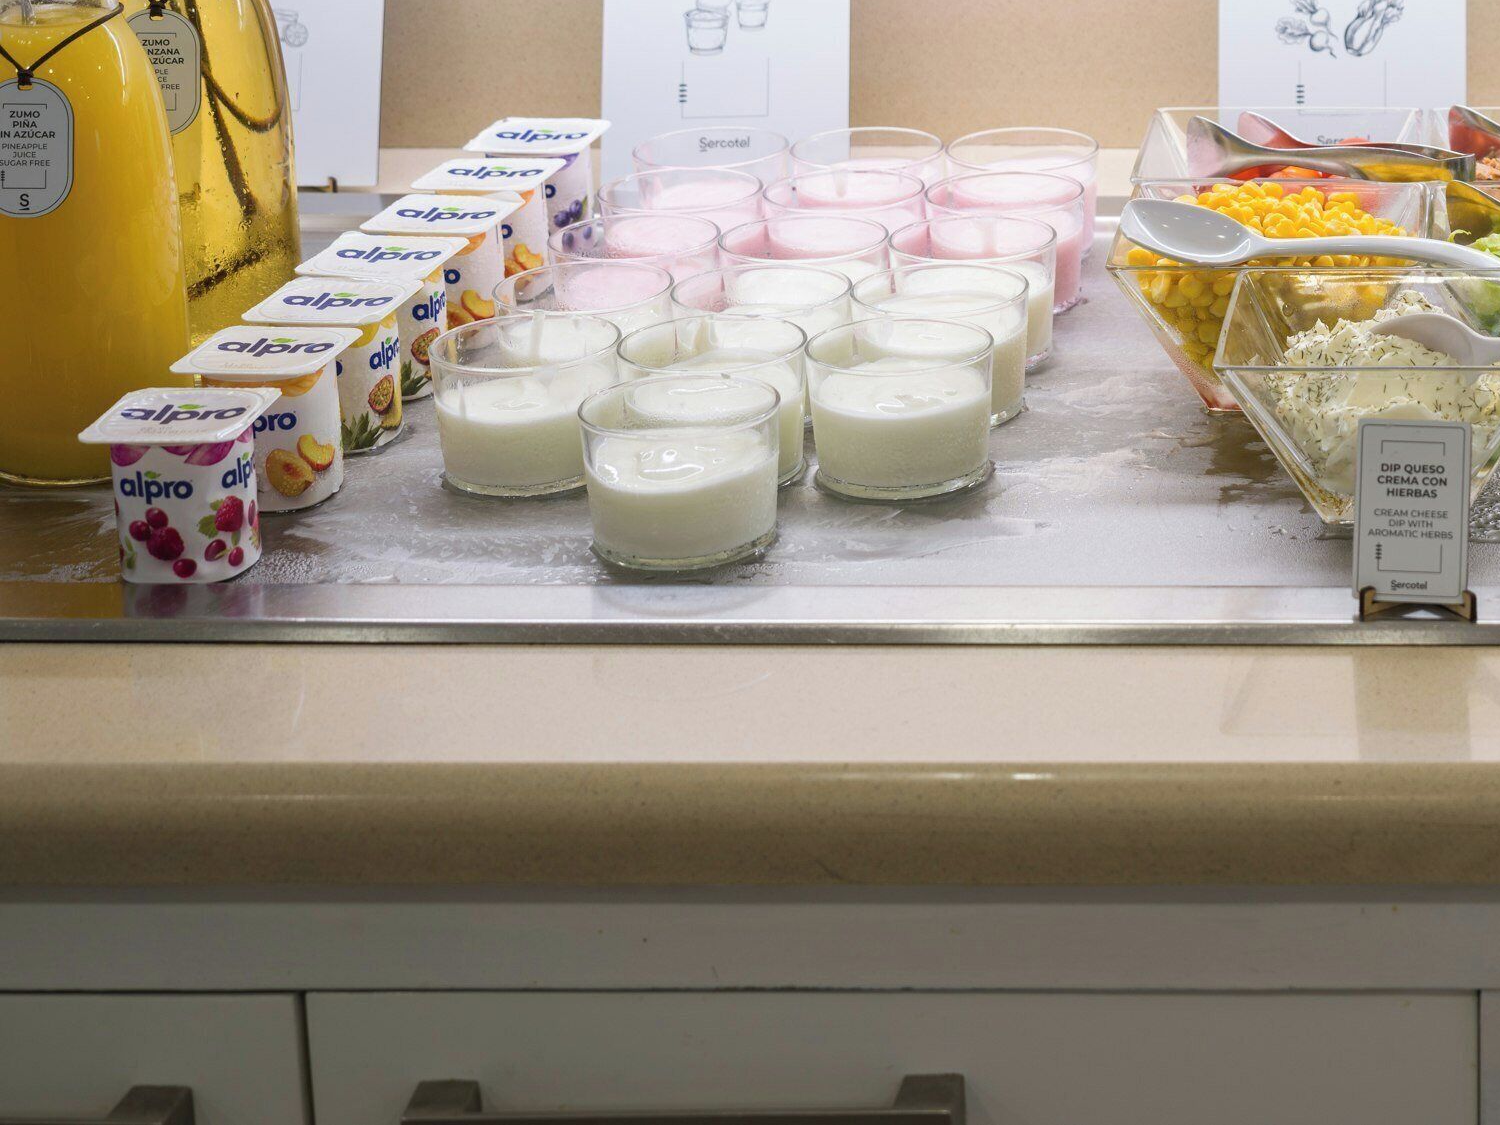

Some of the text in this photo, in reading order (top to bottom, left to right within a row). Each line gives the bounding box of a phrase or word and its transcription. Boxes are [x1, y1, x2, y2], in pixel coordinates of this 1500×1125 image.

[142, 39, 170, 47] ZUMO
[9, 110, 41, 119] ZUMO
[12, 119, 38, 129] PIÑA
[0, 129, 56, 139] IN AZÚCAR
[496, 129, 588, 143] alpro
[699, 136, 750, 151] Sercotel
[12, 151, 36, 159] JUICE
[0, 159, 51, 167] SUGAR FREE
[447, 166, 544, 180] alpro
[19, 193, 30, 209] S
[396, 207, 497, 222] alpro
[336, 246, 442, 263] alpro
[283, 292, 394, 310] alpro
[217, 337, 335, 357] alpro
[121, 404, 247, 424] alpro
[252, 412, 298, 439] pro
[1381, 463, 1445, 474] DIP QUESO
[1377, 475, 1447, 486] CREMA CON
[120, 471, 194, 505] alpro
[1387, 488, 1438, 498] HIERBAS
[1373, 508, 1448, 519] CREAM CHEESE
[1388, 518, 1433, 528] DIP WITH
[1368, 528, 1454, 540] AROMATIC HERBS
[1391, 579, 1428, 591] Sercotel
